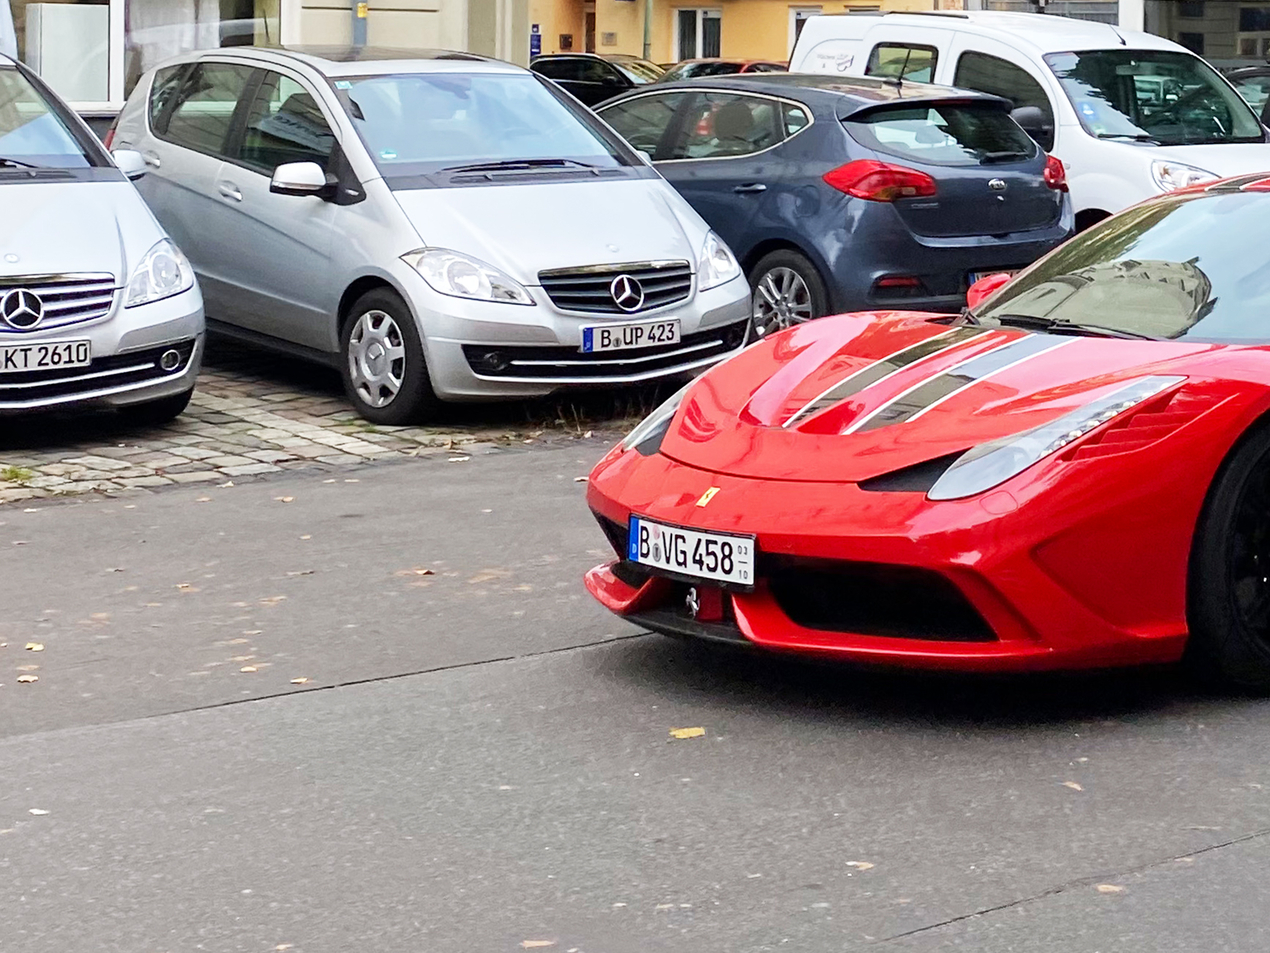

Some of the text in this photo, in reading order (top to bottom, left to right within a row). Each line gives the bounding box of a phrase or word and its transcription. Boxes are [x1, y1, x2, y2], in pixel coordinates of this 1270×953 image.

[601, 329, 612, 348] B
[623, 327, 644, 346] UP
[647, 323, 675, 343] 423
[5, 343, 88, 369] KT 2610
[640, 525, 734, 575] B VG 458
